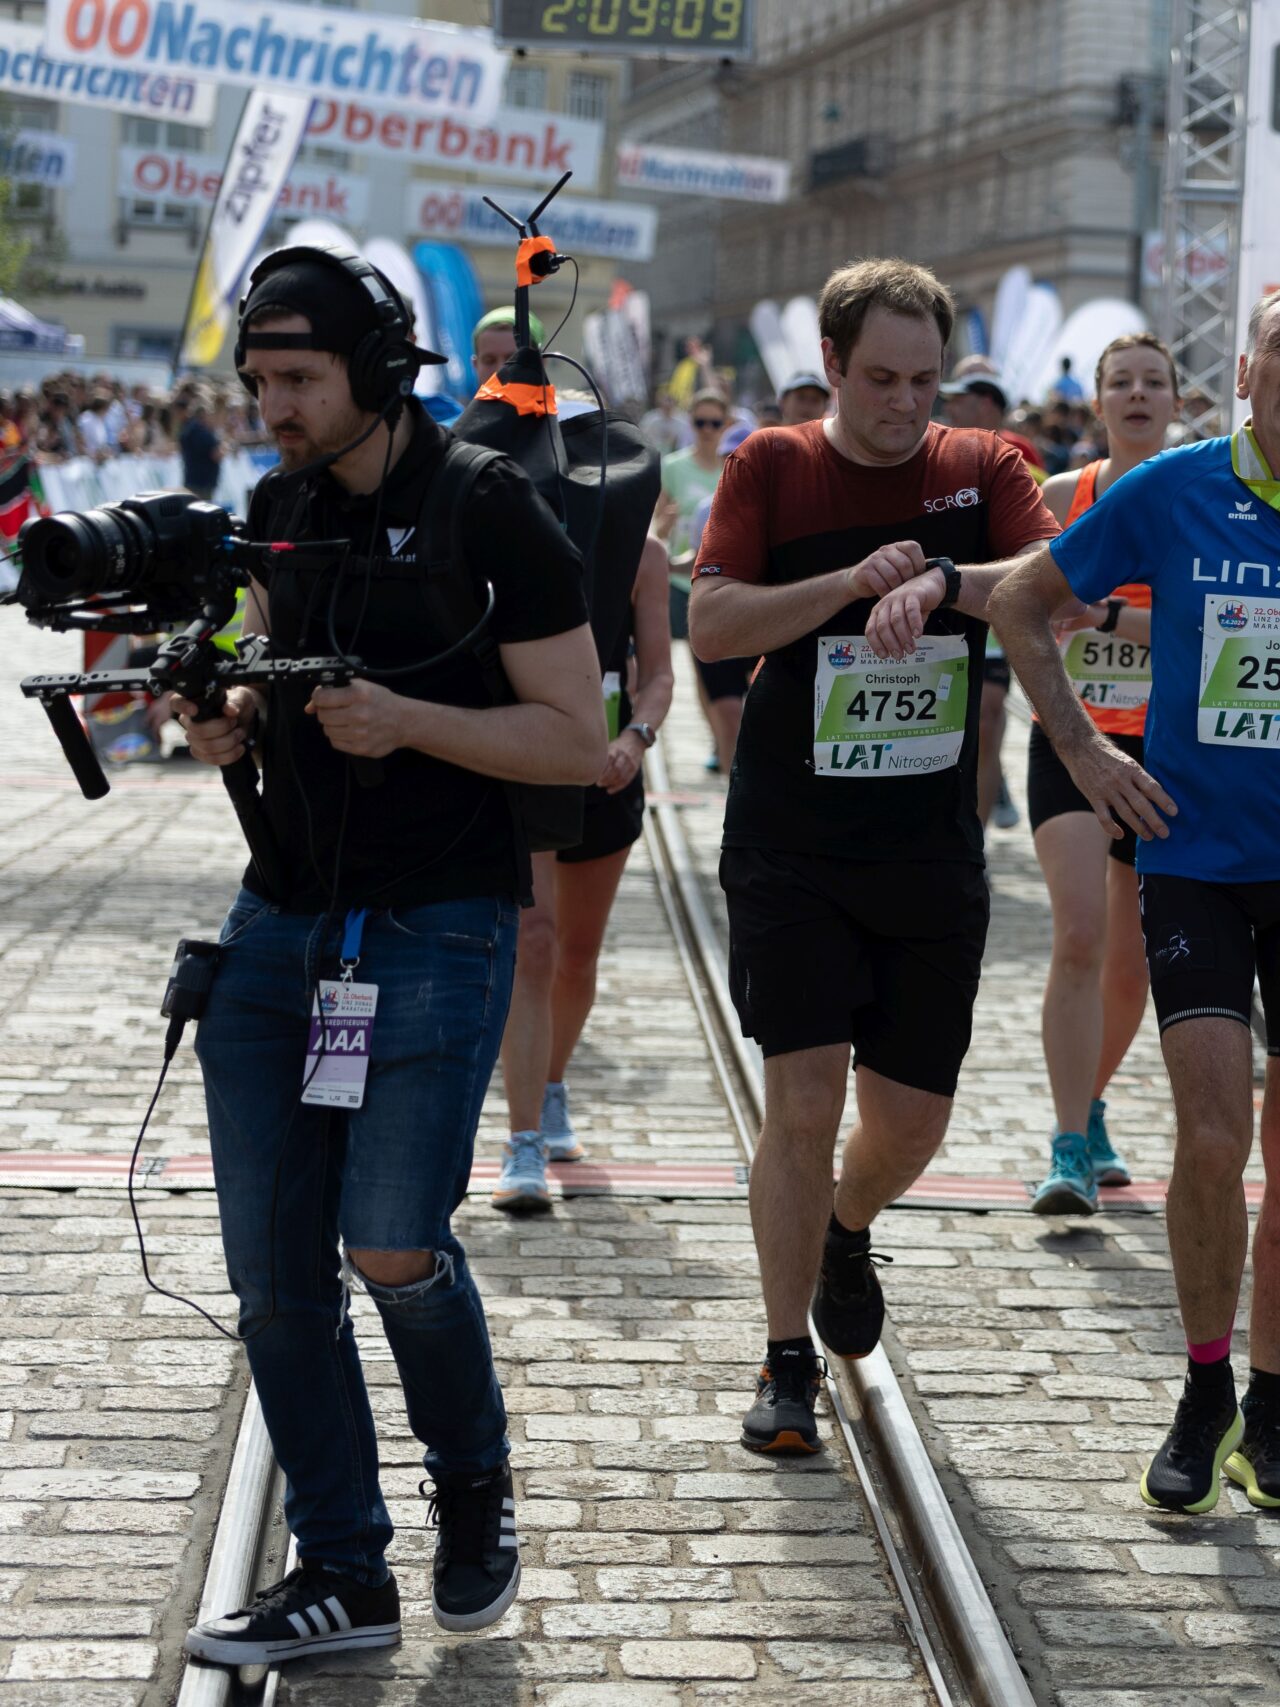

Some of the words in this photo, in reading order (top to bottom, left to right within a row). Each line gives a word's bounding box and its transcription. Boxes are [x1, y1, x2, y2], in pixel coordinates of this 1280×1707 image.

[1254, 608, 1266, 616] 22.
[1083, 642, 1151, 669] 5187
[865, 674, 921, 685] Christoph
[1080, 683, 1108, 702] AT
[847, 689, 937, 722] 4752
[1214, 711, 1276, 740] LAT
[830, 744, 886, 770] LAT
[888, 754, 948, 771] Nitrogen
[316, 1018, 369, 1026] AKREDITIERUNG
